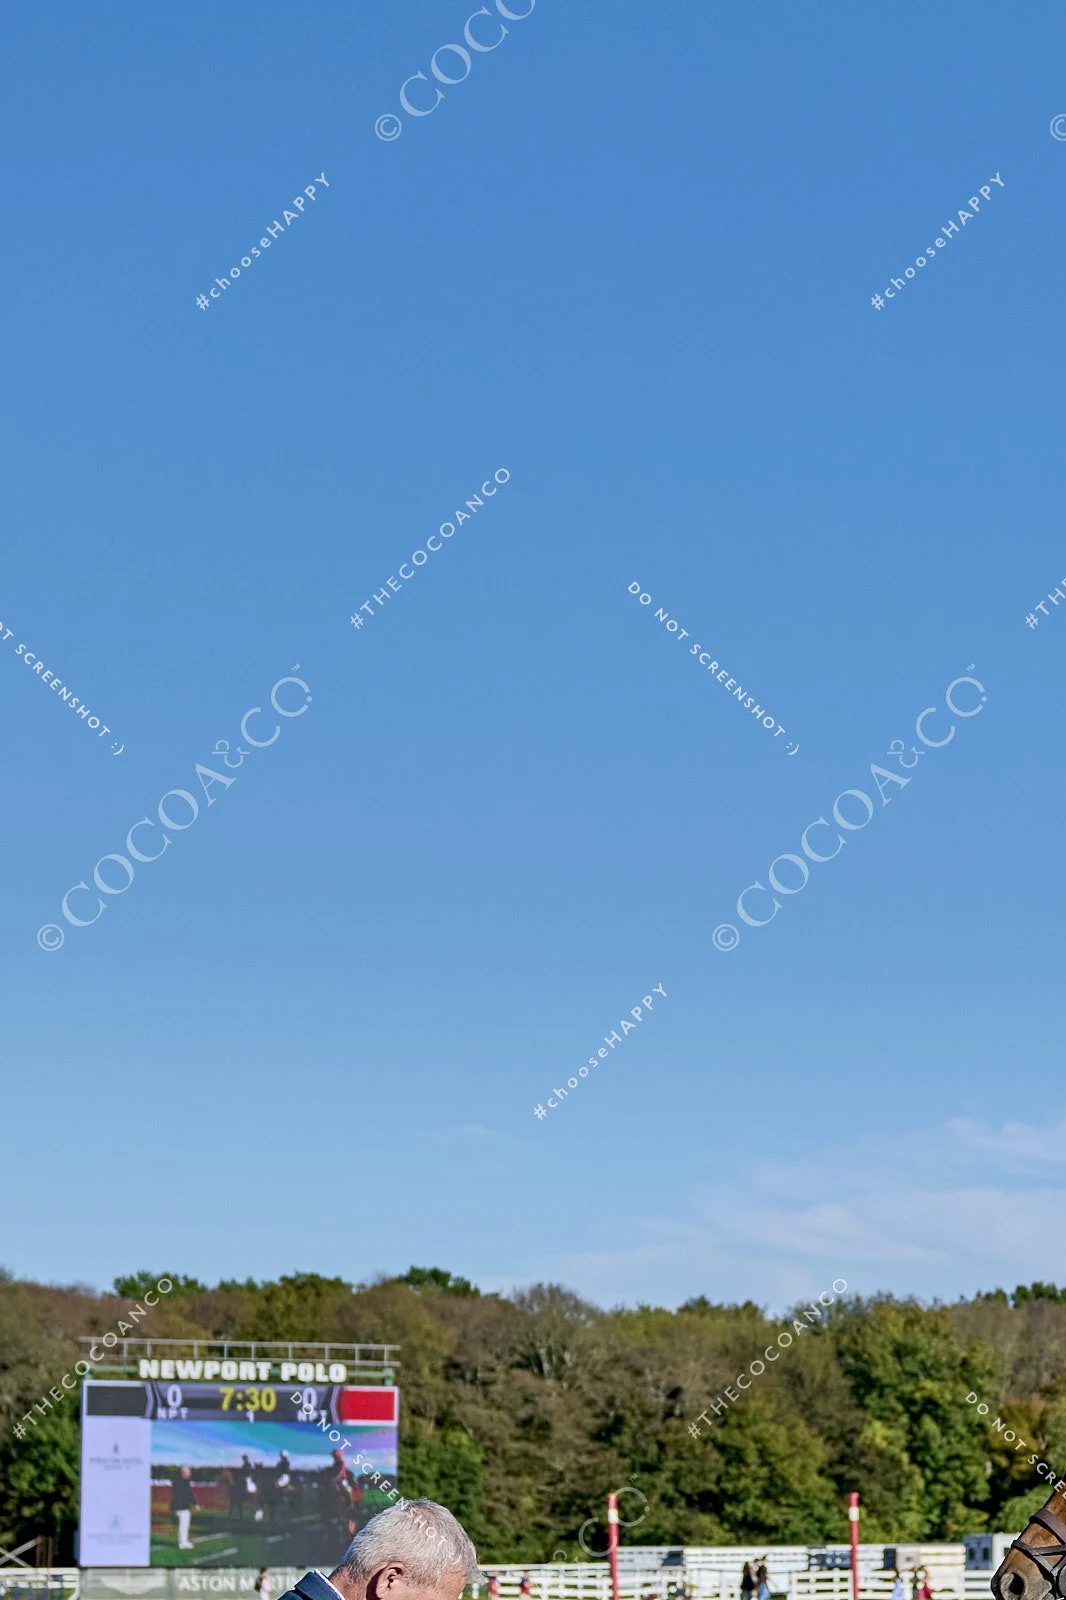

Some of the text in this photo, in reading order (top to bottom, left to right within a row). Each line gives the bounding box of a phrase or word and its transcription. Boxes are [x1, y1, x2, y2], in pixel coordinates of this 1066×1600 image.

[138, 1358, 347, 1383] NEWPORT POLO
[167, 1384, 182, 1408] 0
[219, 1386, 277, 1413] 7:30
[157, 1407, 188, 1420] NPT
[178, 1575, 302, 1592] ASTON MRTIN
